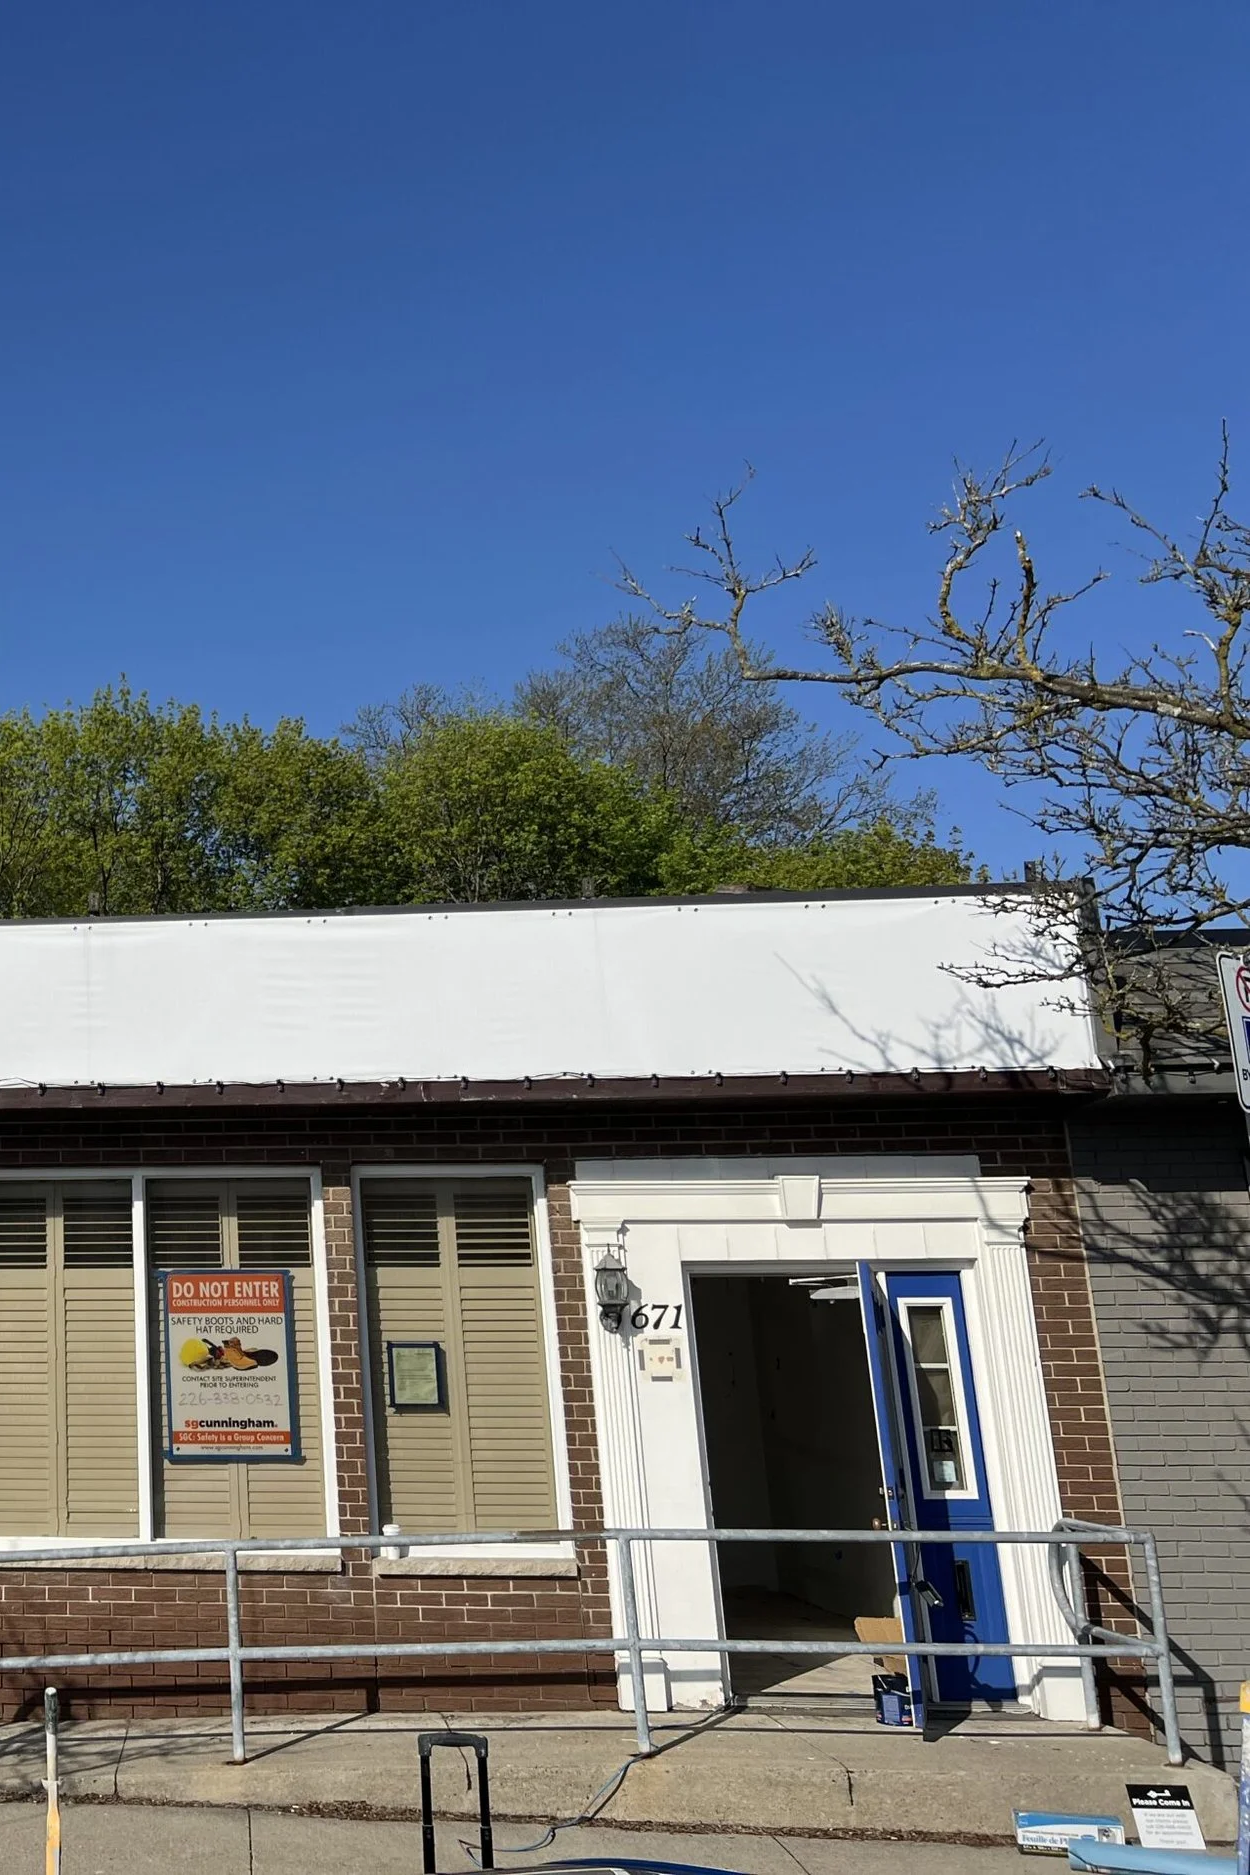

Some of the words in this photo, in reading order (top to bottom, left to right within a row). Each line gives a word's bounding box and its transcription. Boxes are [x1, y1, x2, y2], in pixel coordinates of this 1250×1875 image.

[172, 1281, 194, 1298] DO
[199, 1281, 229, 1298] NOT
[234, 1281, 279, 1297] ENTER
[172, 1299, 222, 1307] CONSTRUCTION
[224, 1299, 261, 1307] PERSONNEL
[263, 1299, 279, 1307] ONLY
[631, 1303, 683, 1330] 671
[171, 1317, 203, 1325] SAFETY
[205, 1317, 234, 1325] BOOTS
[236, 1317, 256, 1325] AND
[257, 1317, 283, 1325] HARD
[215, 1326, 259, 1334] REQUIRED
[178, 1433, 196, 1441] SGC:
[197, 1433, 218, 1442] Safety
[220, 1433, 226, 1441] is
[233, 1433, 254, 1442] Group
[256, 1433, 284, 1441] Concern
[1132, 1798, 1158, 1806] Please
